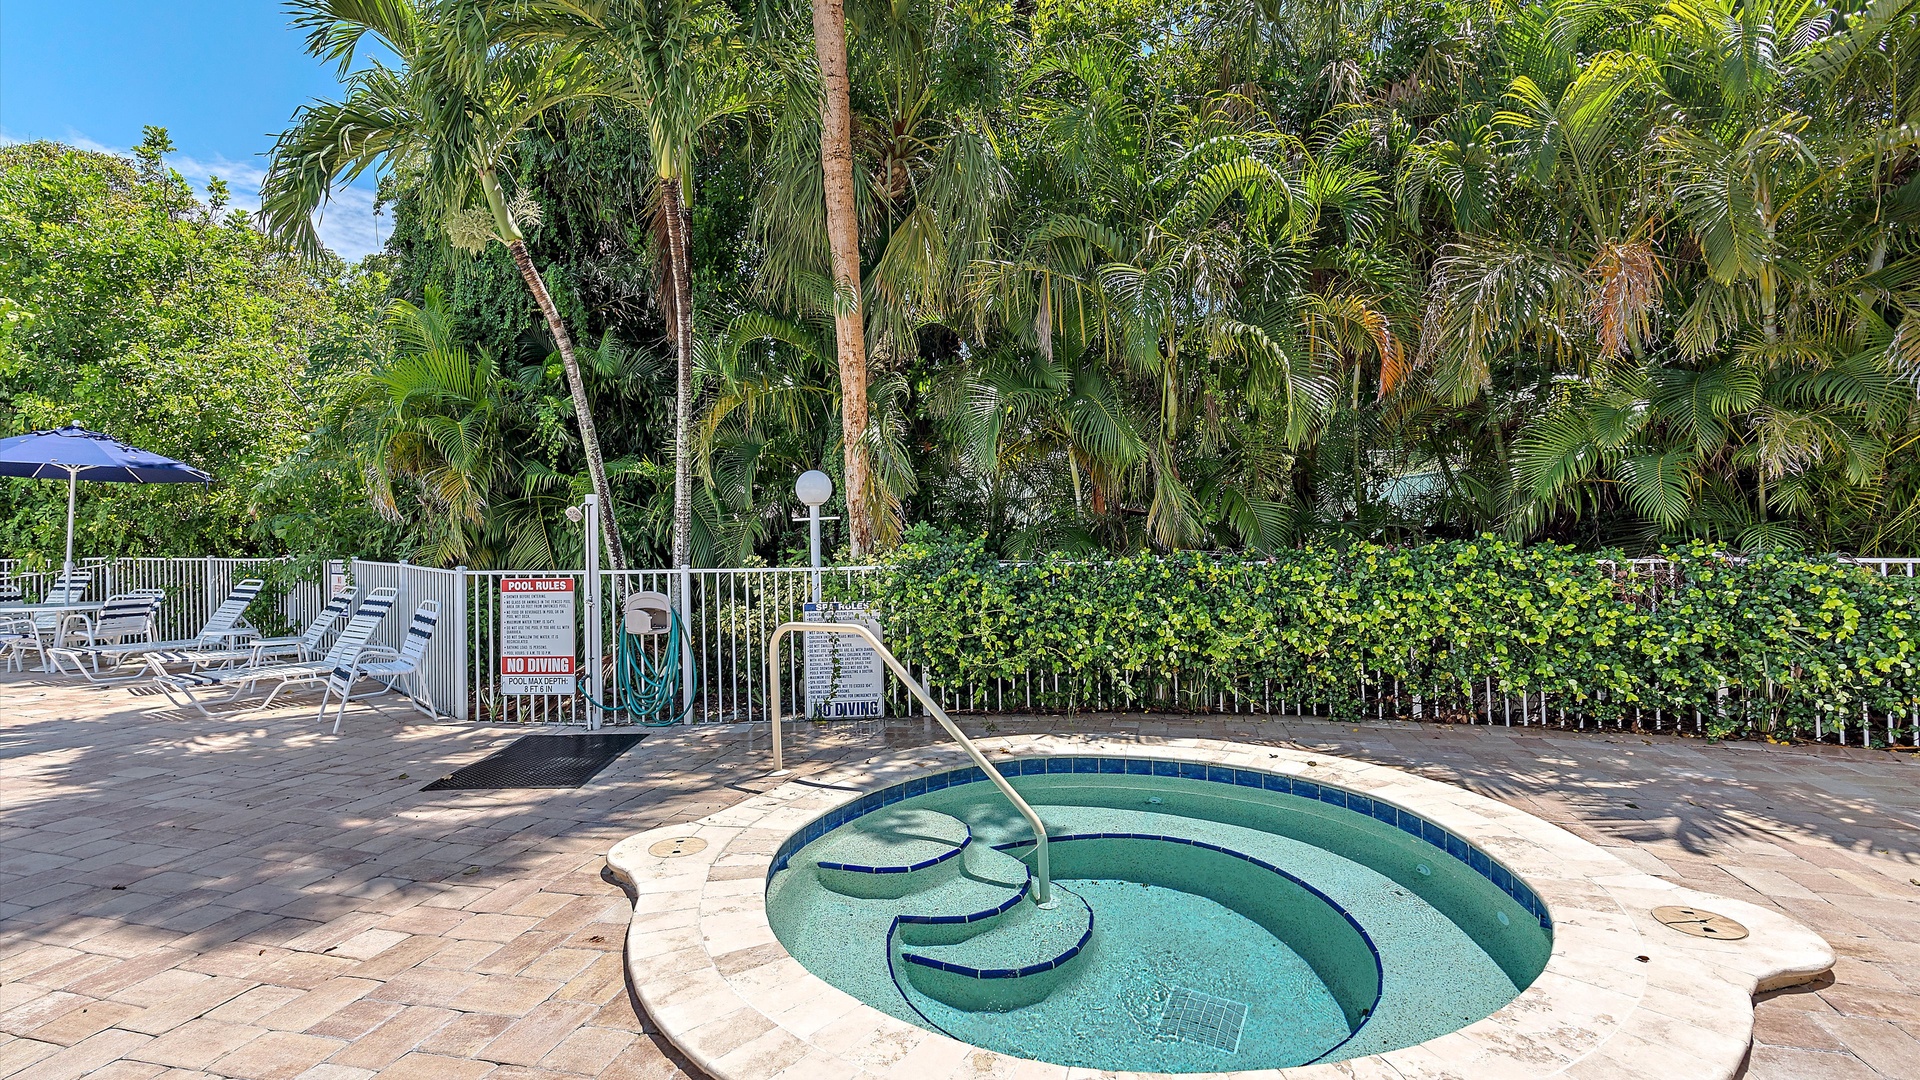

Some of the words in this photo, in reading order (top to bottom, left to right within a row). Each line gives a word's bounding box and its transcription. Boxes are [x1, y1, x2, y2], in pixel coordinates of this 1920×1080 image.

[508, 581, 533, 590] POOL
[536, 581, 566, 590] RULES
[507, 658, 524, 672] NO
[528, 658, 569, 672] DIVING
[835, 702, 879, 716] DIVING
